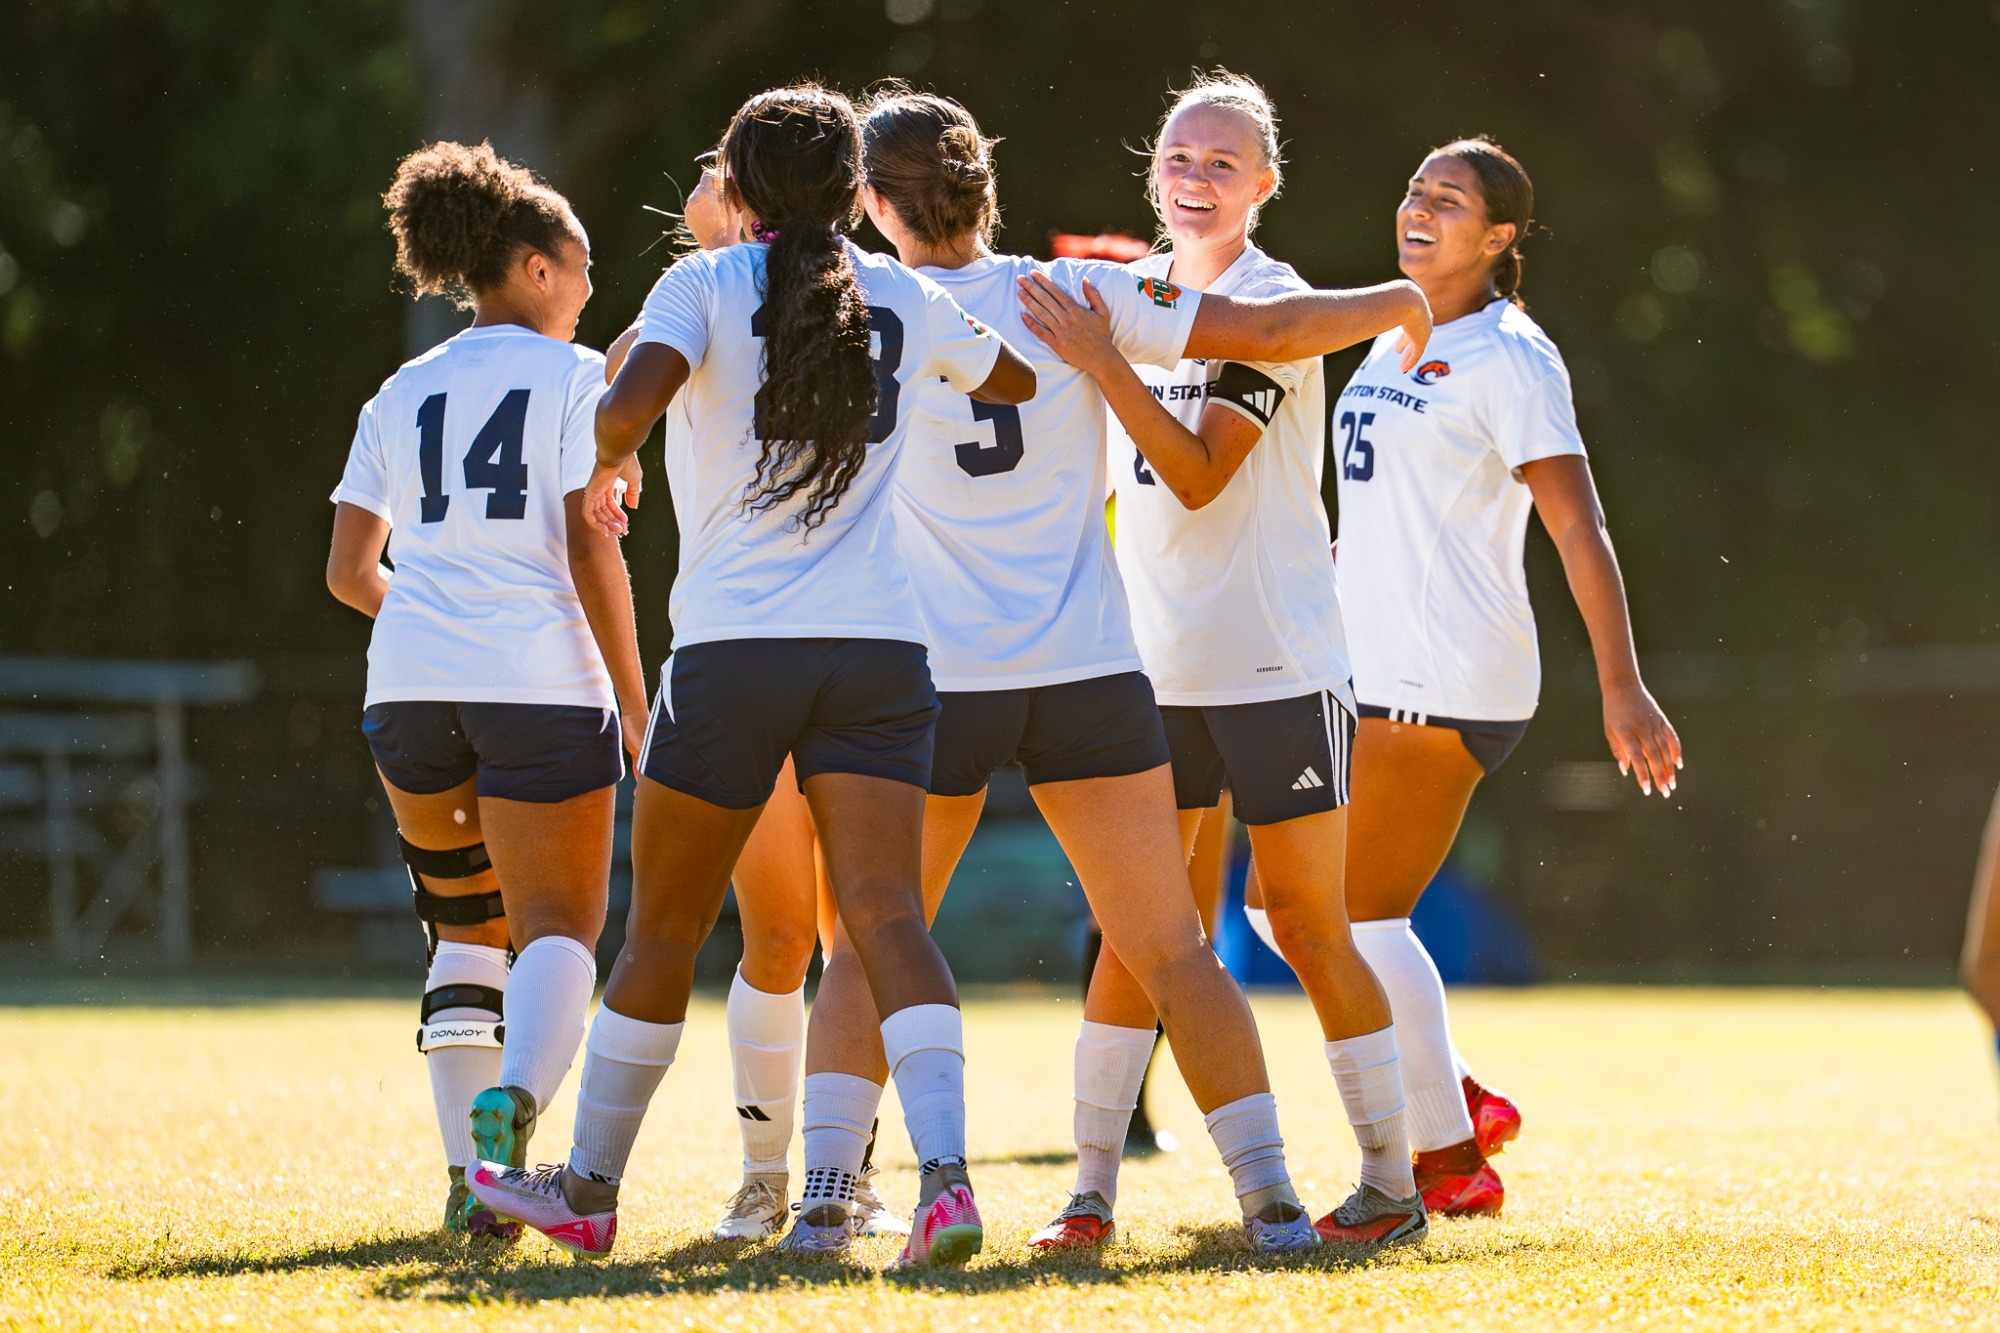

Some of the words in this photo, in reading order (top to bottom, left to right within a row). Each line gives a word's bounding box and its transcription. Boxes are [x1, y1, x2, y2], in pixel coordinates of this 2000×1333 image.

[1377, 386, 1428, 415] STATE
[415, 388, 532, 525] 14
[1340, 411, 1377, 483] 25
